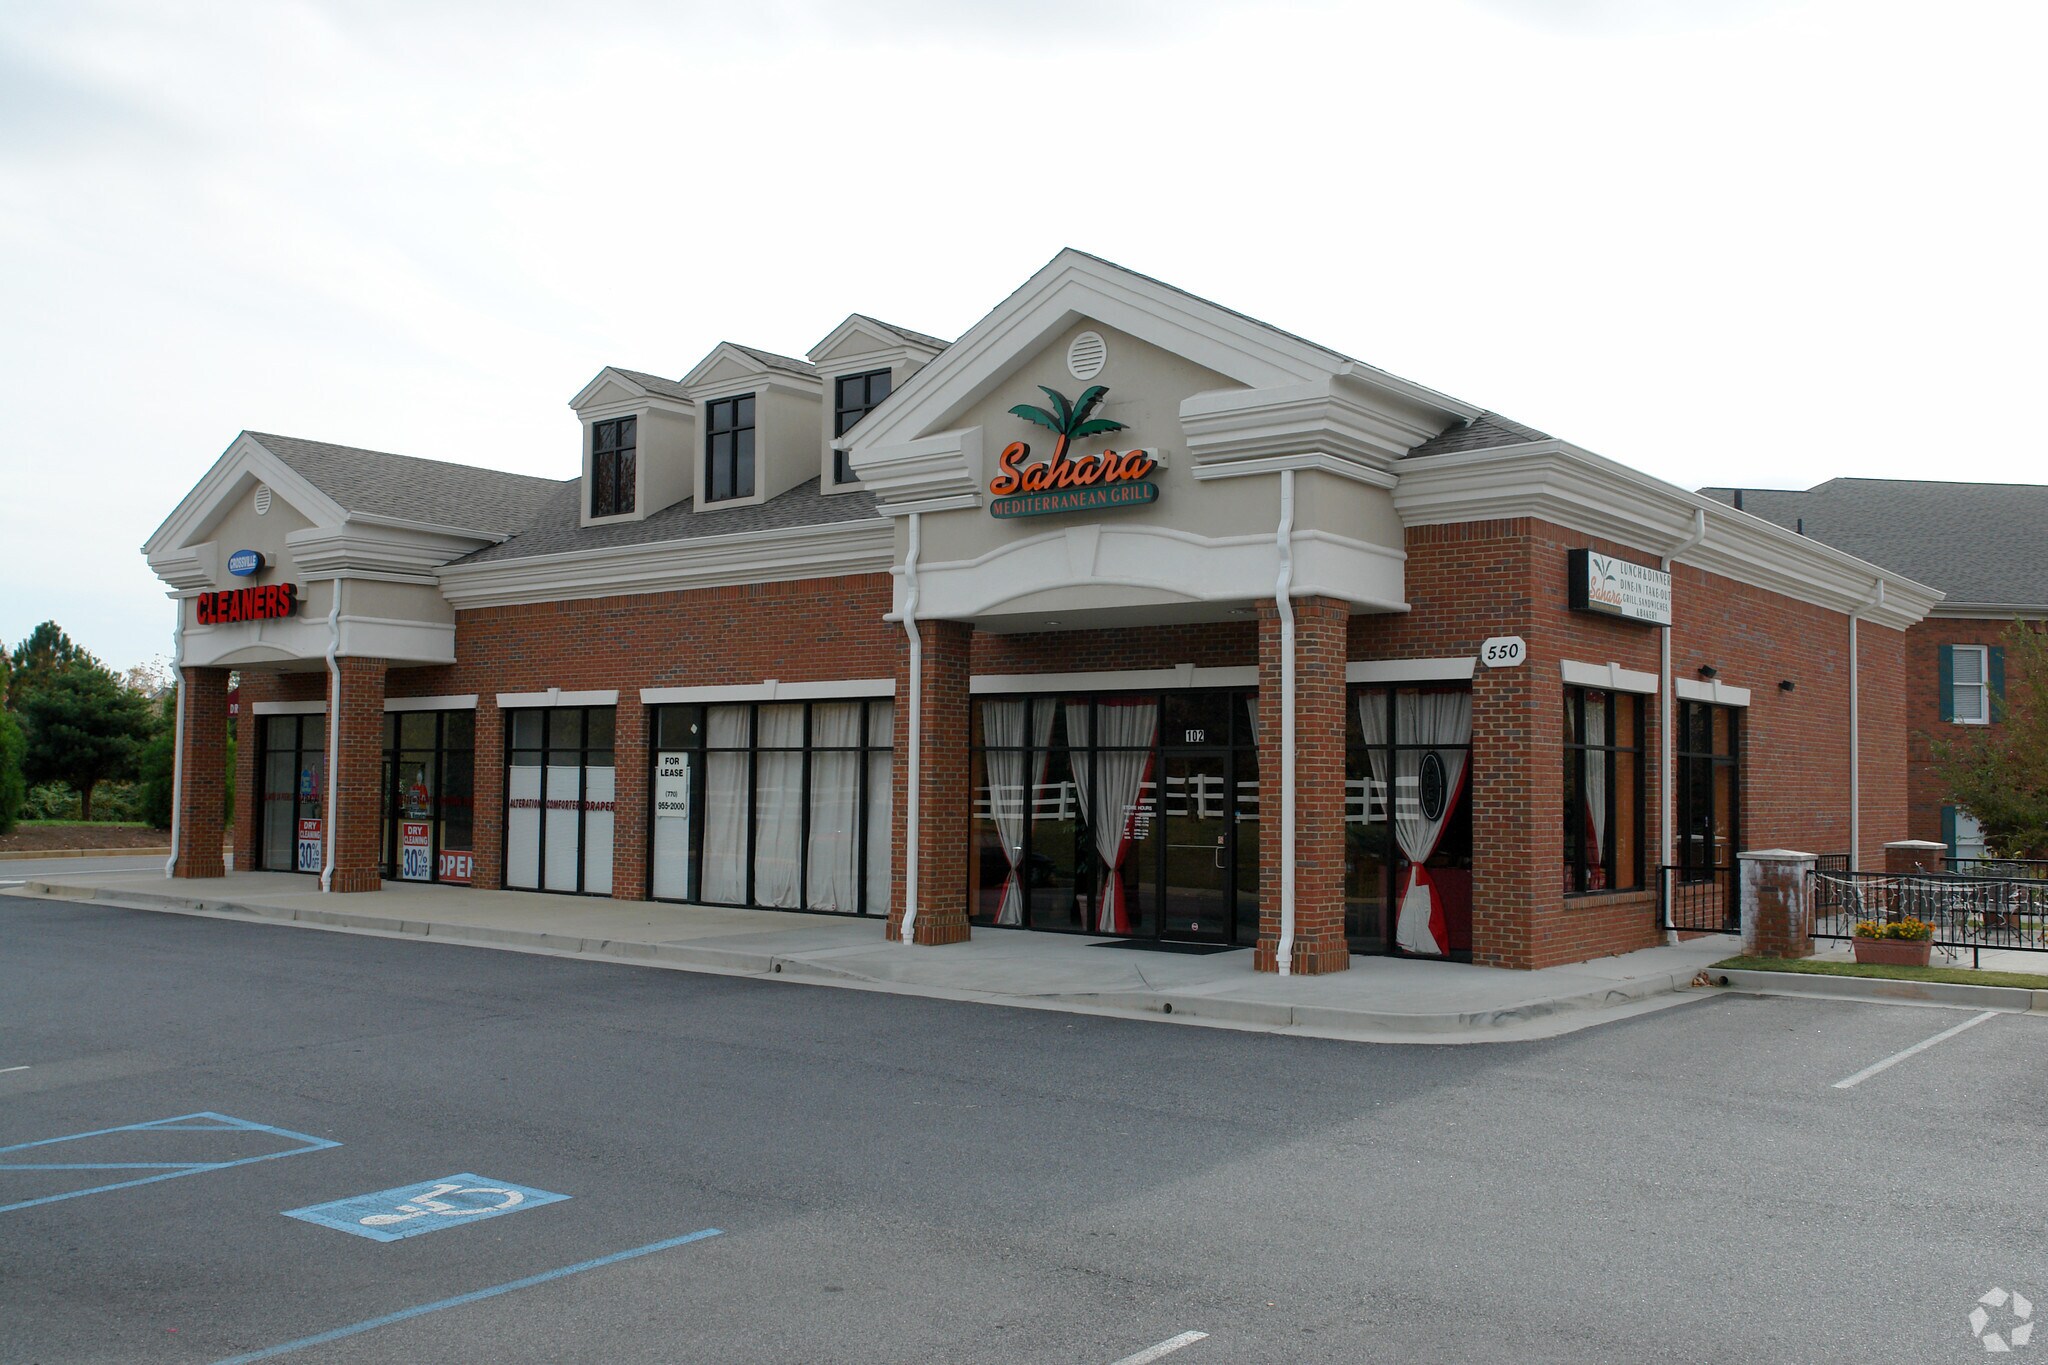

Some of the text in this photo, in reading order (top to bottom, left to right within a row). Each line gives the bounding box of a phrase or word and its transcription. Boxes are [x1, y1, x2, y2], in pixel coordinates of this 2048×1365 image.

[990, 433, 1153, 495] Sahara
[993, 484, 1151, 515] MEDITERRANEAN GRILL
[229, 555, 257, 569] CROSSVILLE
[1590, 576, 1622, 605] Sahara
[197, 583, 292, 625] CLEANERS
[1488, 644, 1518, 660] 550
[1187, 730, 1203, 742] 102
[665, 757, 680, 765] FOR
[660, 769, 684, 777] LEASE
[665, 790, 678, 798] (770)
[658, 802, 685, 811] 955-2000
[304, 822, 317, 830] DRY
[408, 826, 423, 834] DRY
[404, 836, 428, 845] CLEANING
[418, 865, 428, 877] OFF
